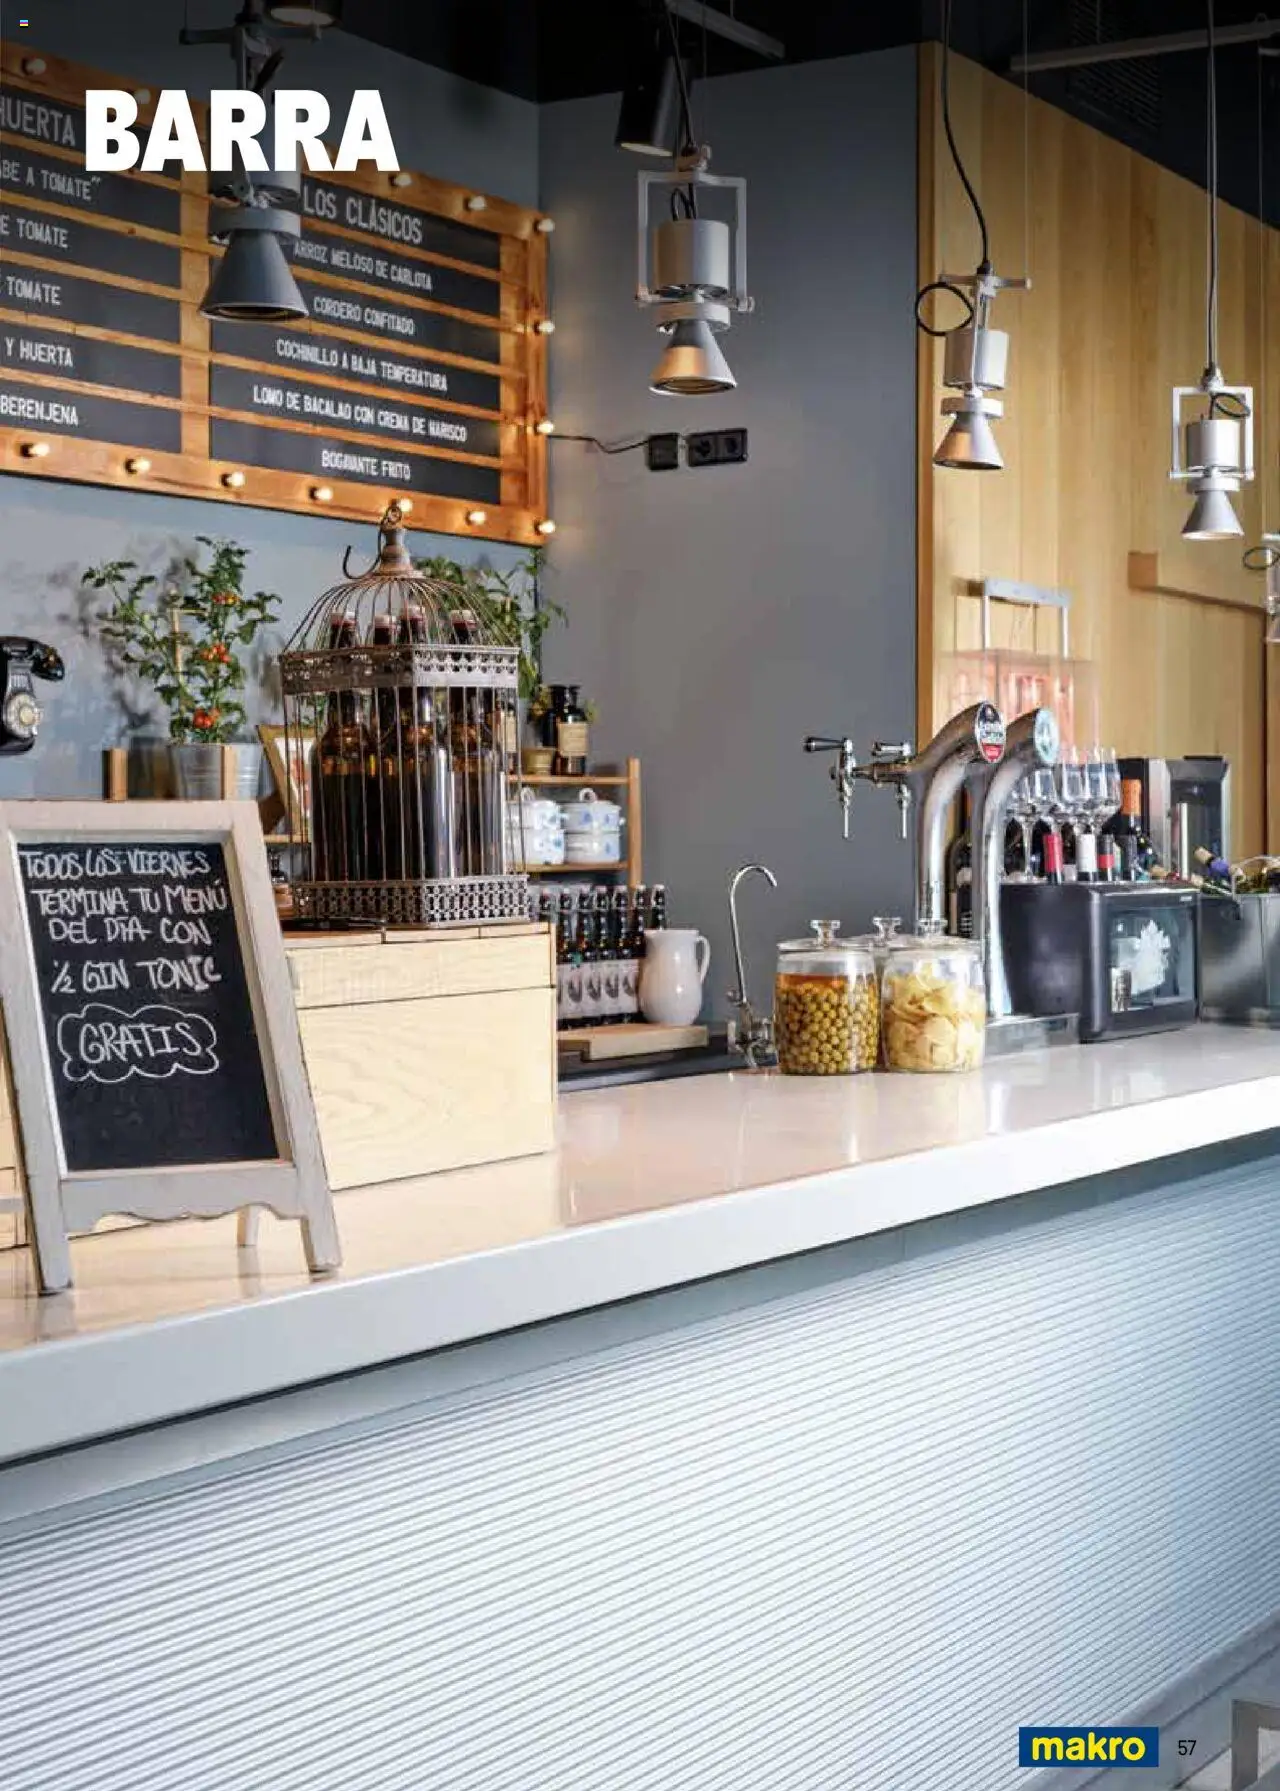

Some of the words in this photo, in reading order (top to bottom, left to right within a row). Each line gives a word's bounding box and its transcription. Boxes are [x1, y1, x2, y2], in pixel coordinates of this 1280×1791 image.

[0, 159, 20, 181] BE
[26, 166, 35, 187] A
[303, 184, 337, 219] LOS
[16, 218, 69, 249] TOMATE
[293, 239, 328, 264] ARROZ
[331, 247, 374, 275] MELOSO
[375, 259, 389, 279] DE
[6, 275, 61, 306] TOMATE
[313, 295, 361, 322] CORDERO
[4, 336, 15, 357] Y
[20, 338, 74, 368] HUERTA
[276, 338, 338, 367] COCHINILLO
[341, 351, 349, 370] A
[351, 354, 377, 377] BAJA
[380, 360, 448, 392] TEMPERATURA
[0, 394, 79, 427] BERENJENA
[253, 385, 283, 408] LOMO
[286, 390, 301, 411] DE
[303, 394, 351, 420] BACALAO
[354, 405, 375, 425] CON
[377, 410, 410, 432] CREMA
[412, 416, 426, 435] DE
[429, 419, 468, 443] MARISCO
[321, 450, 379, 477] BOGAVANTE
[382, 460, 411, 481] FRITO
[127, 850, 211, 879] VIERNES
[31, 886, 129, 918] TERMINA
[129, 887, 161, 914] TU
[163, 879, 228, 914] MENÚ
[49, 917, 97, 945] DEL
[160, 918, 212, 946] CON
[82, 958, 130, 993] GIN
[136, 955, 222, 992] TONIC
[79, 1021, 202, 1064] GRATIS
